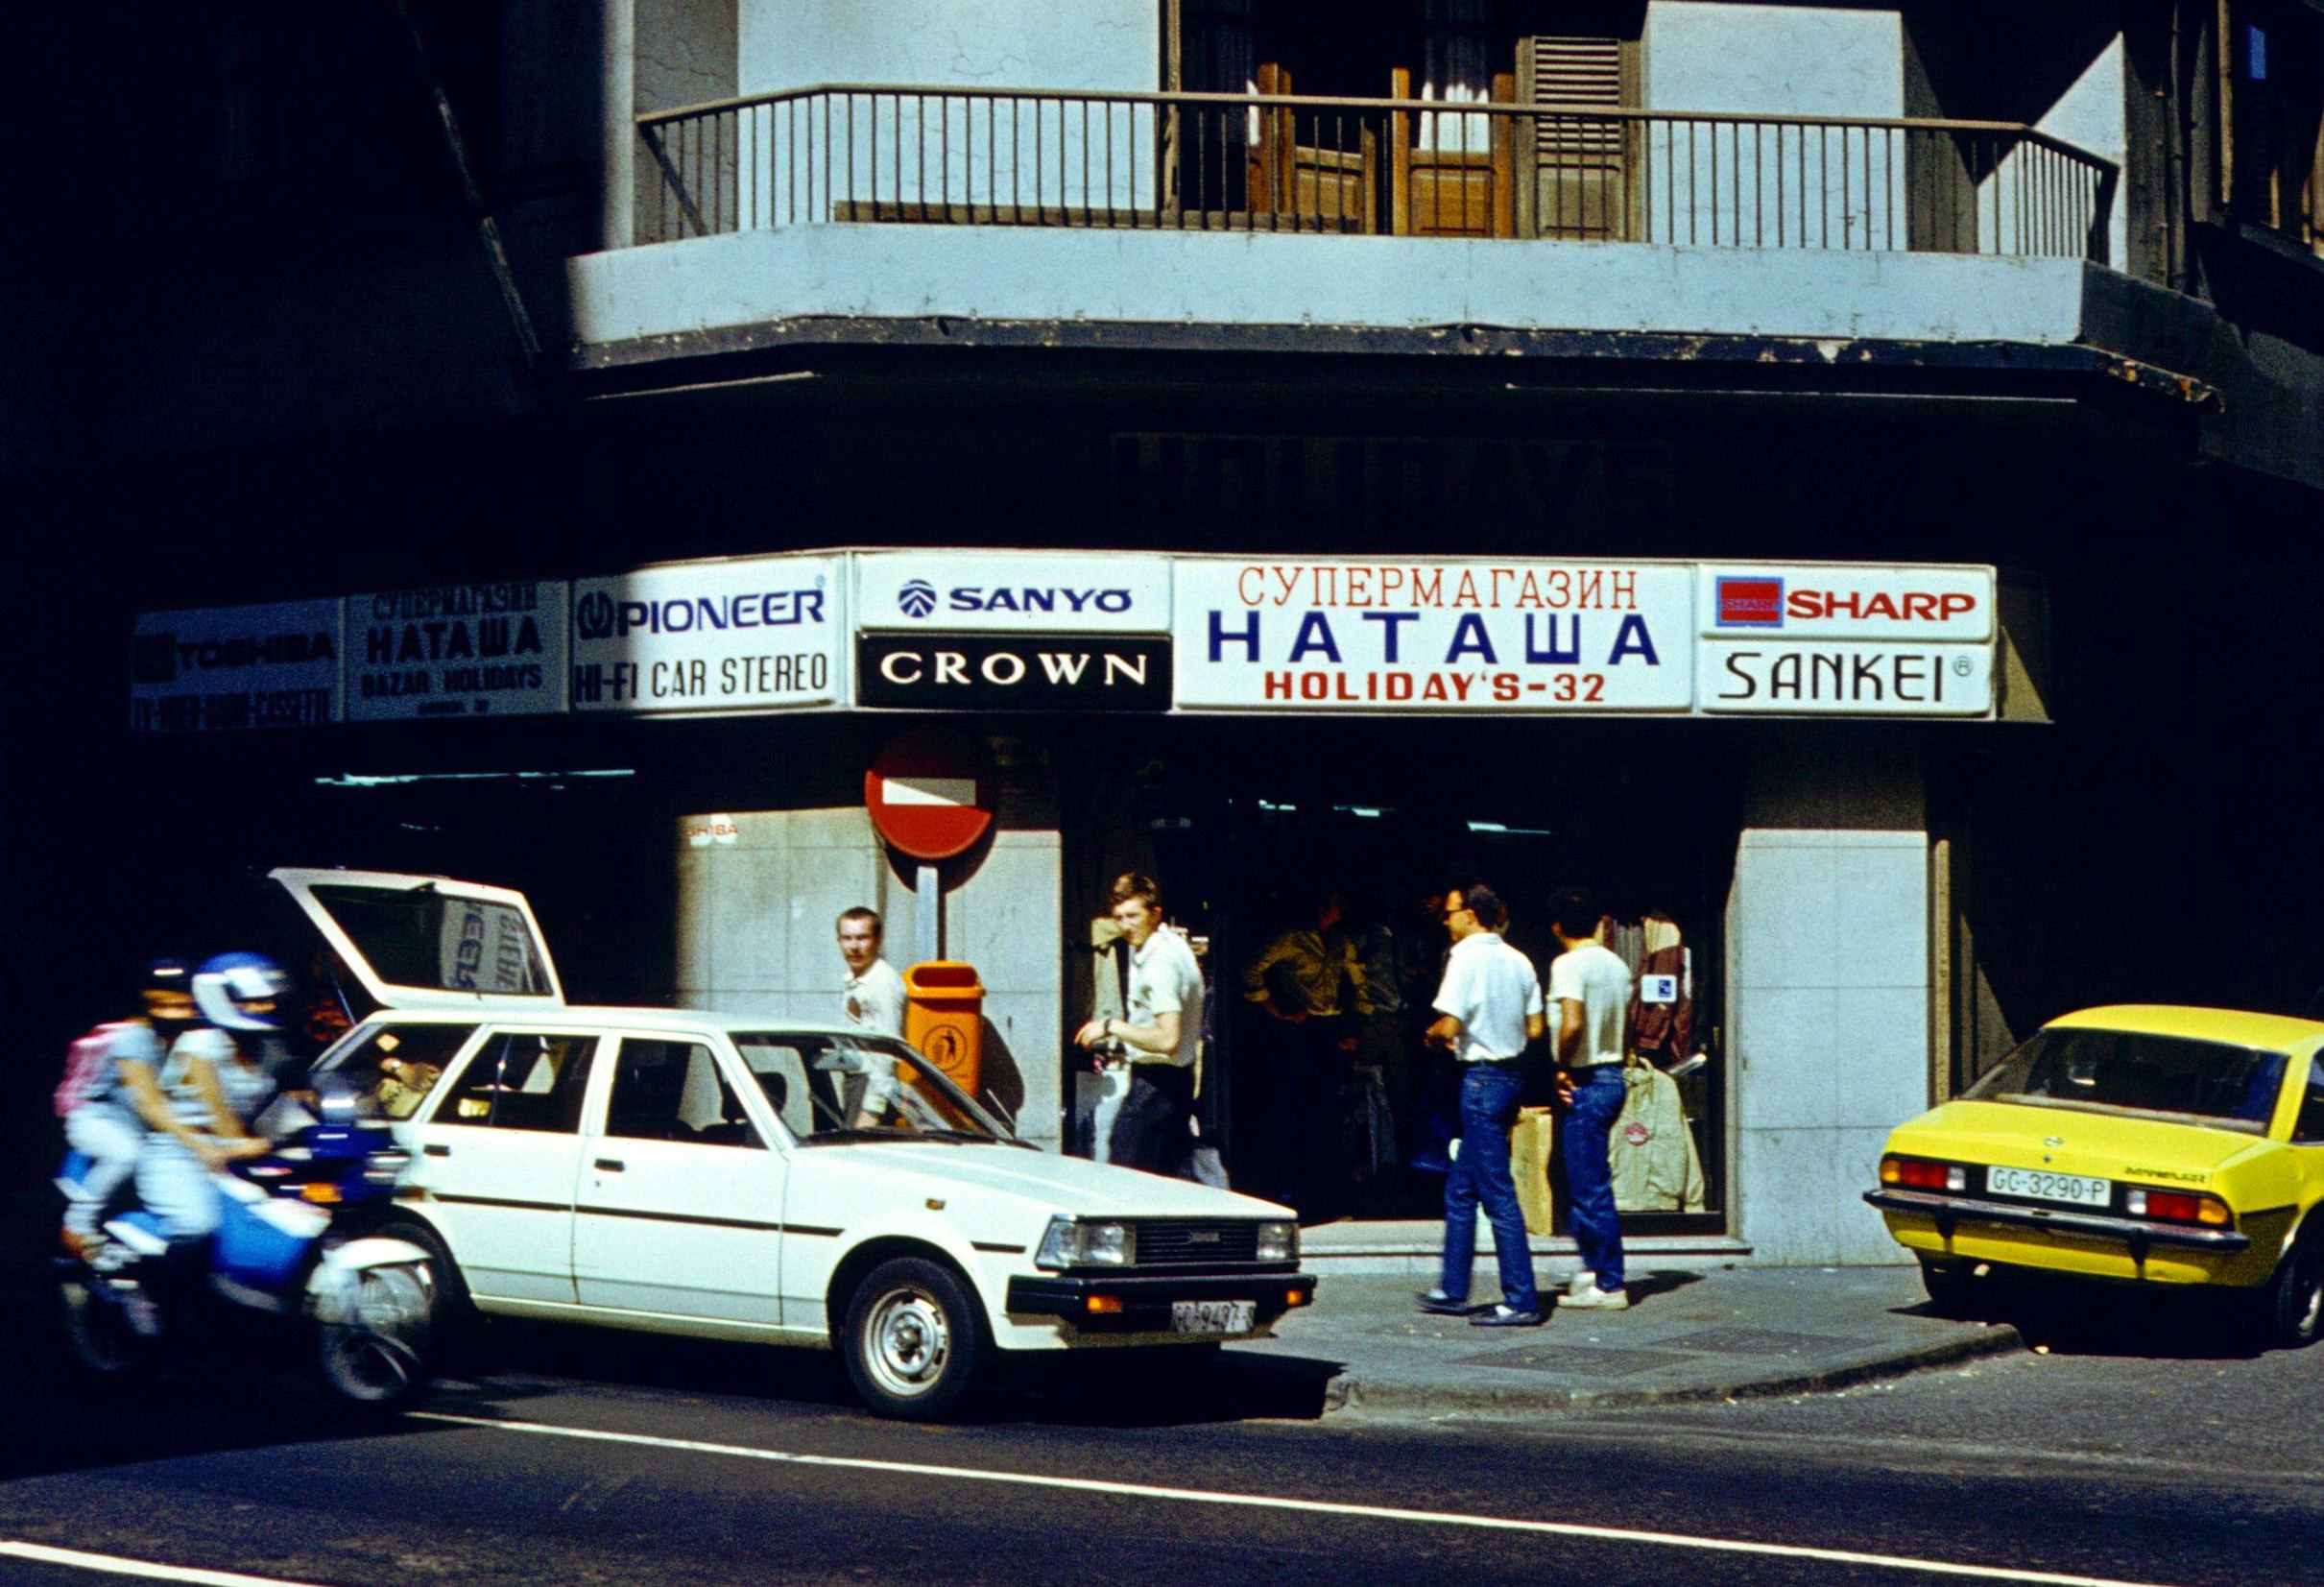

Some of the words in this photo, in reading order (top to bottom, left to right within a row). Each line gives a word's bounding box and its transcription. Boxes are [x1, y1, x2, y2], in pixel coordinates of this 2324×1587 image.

[949, 587, 1133, 613] SANYO
[1237, 566, 1638, 609] СУПЕРМАГАЗИН
[1786, 589, 1976, 621] SHARP
[615, 589, 825, 637] PIONEER
[368, 615, 544, 664] НАТАША
[1207, 610, 1661, 665] НАТАША
[576, 661, 637, 703] HI-FI
[651, 659, 707, 698] CAR
[720, 652, 828, 695] STEREO
[879, 650, 1147, 685] CROWN
[1264, 670, 1606, 703] HOLIDAY'S-32
[1717, 652, 1943, 702] SANKEI
[1993, 1169, 2106, 1201] GC-3290-P
